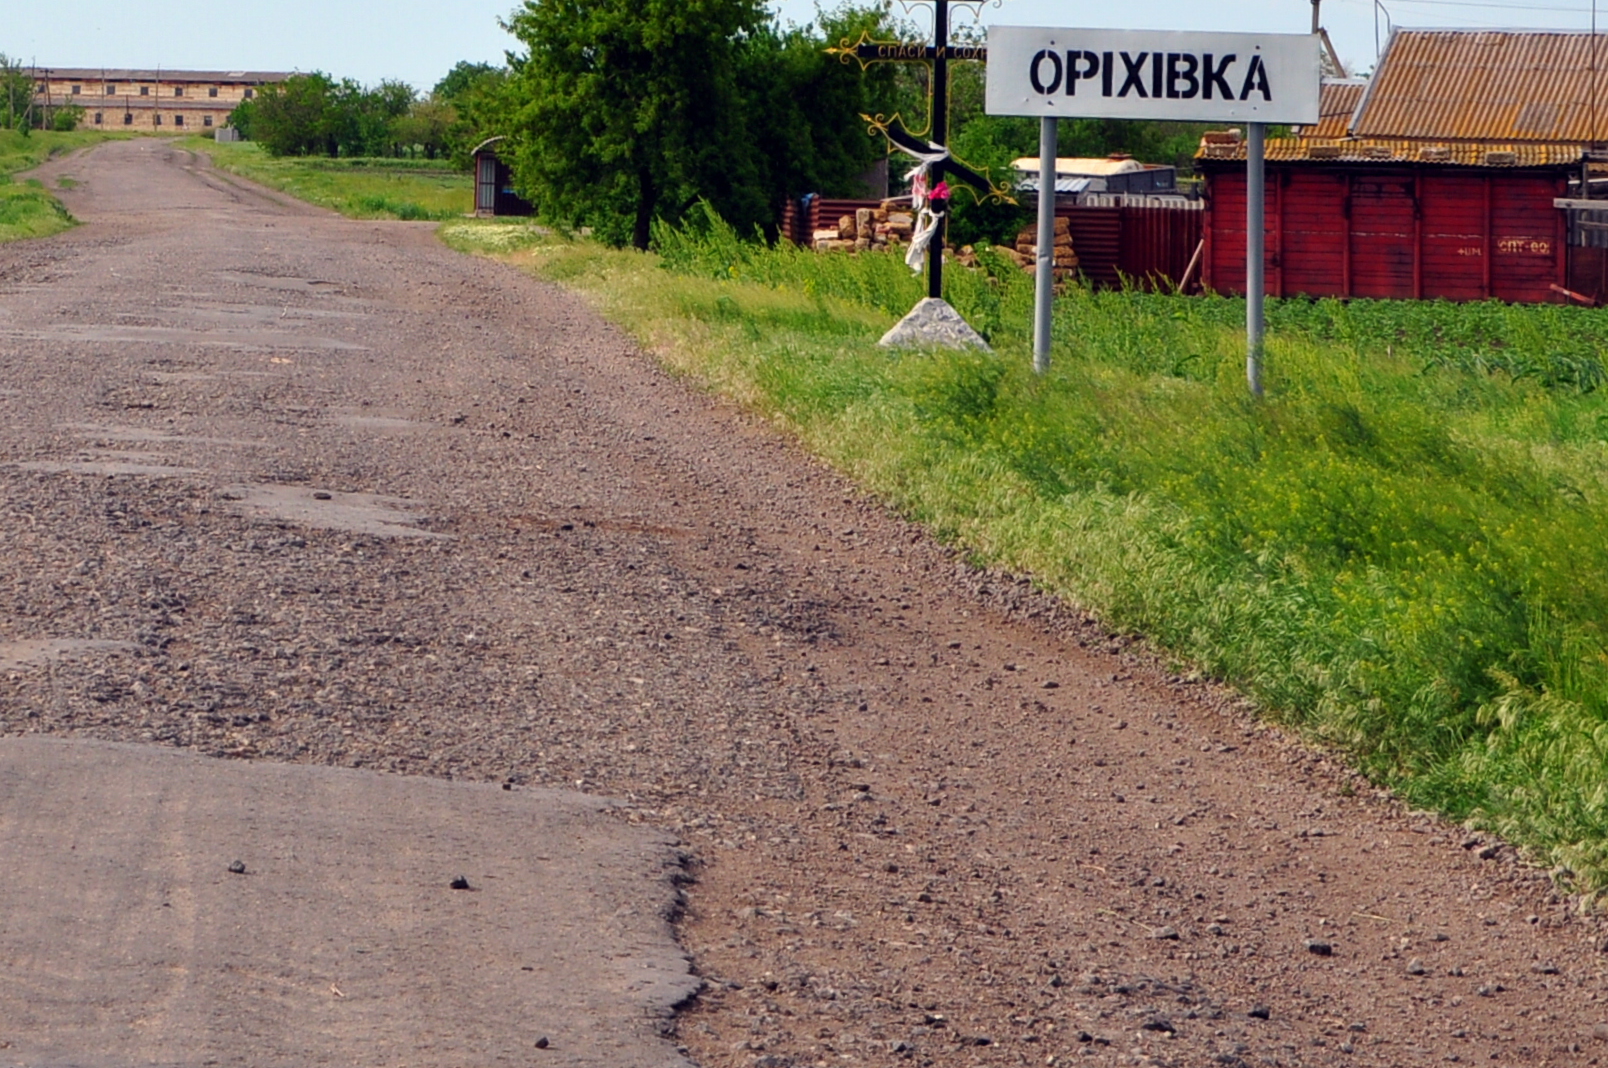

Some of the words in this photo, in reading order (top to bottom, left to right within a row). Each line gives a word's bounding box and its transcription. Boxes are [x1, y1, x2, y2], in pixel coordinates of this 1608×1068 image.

[878, 45, 927, 58] СПАСИ
[936, 45, 946, 59] И
[1029, 48, 1272, 102] ОРІХІВКА
